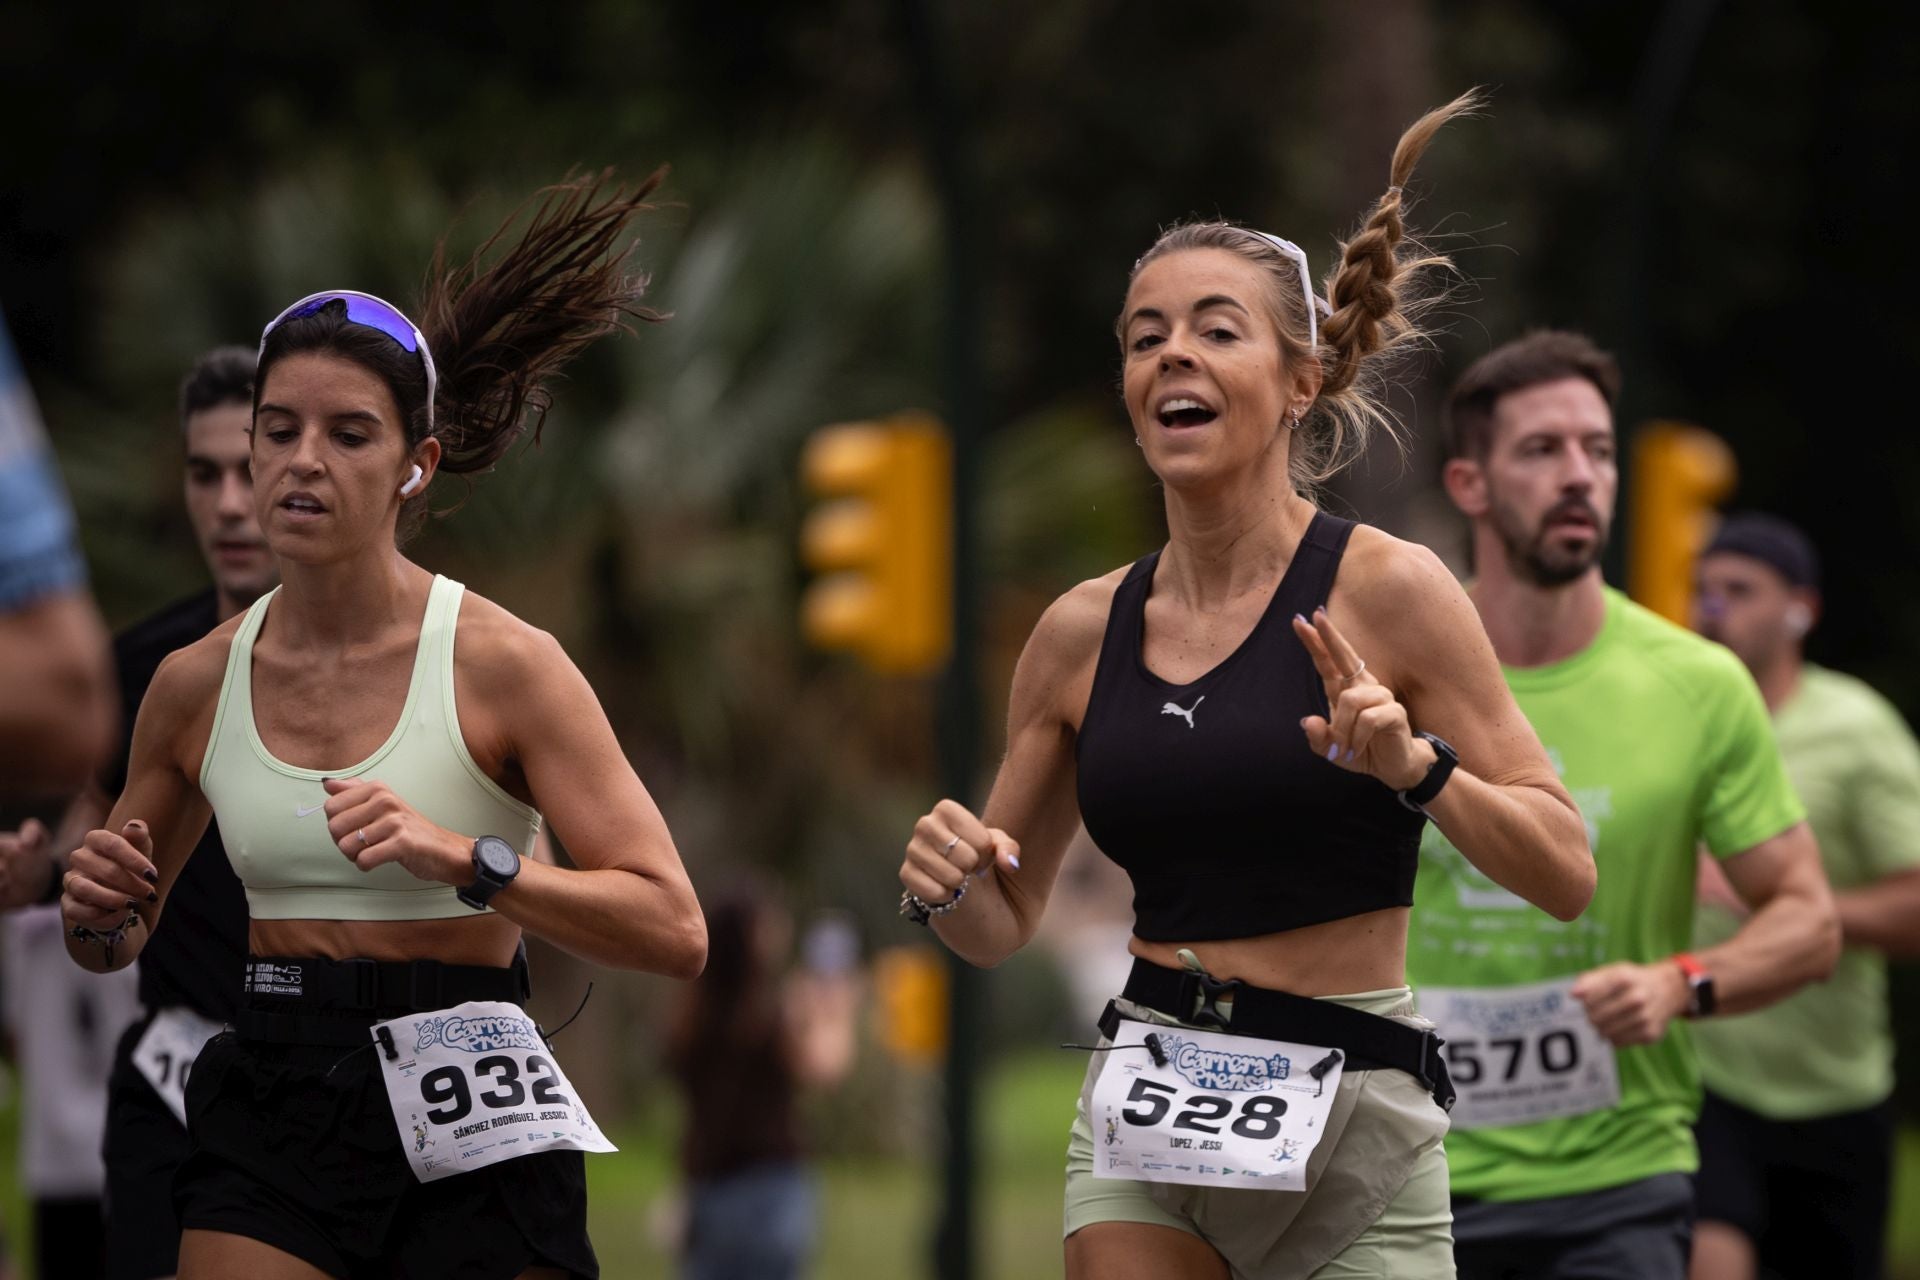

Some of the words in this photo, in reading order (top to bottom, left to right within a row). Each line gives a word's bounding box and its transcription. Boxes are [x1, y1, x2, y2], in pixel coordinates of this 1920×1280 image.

[444, 1018, 528, 1043] Carrera
[466, 1033, 537, 1051] Prensa
[1178, 1045, 1269, 1077] Carrera
[1447, 1030, 1580, 1084] 570
[420, 1055, 571, 1125] 932
[1193, 1068, 1272, 1091] Prensa
[1122, 1077, 1288, 1140] 528
[453, 1121, 490, 1139] SÁNCHEZ
[491, 1111, 538, 1129] RODRÍGUEZ,
[540, 1110, 568, 1121] JESSICA
[1170, 1137, 1192, 1148] LOPEZ
[1200, 1140, 1223, 1151] JESSI
